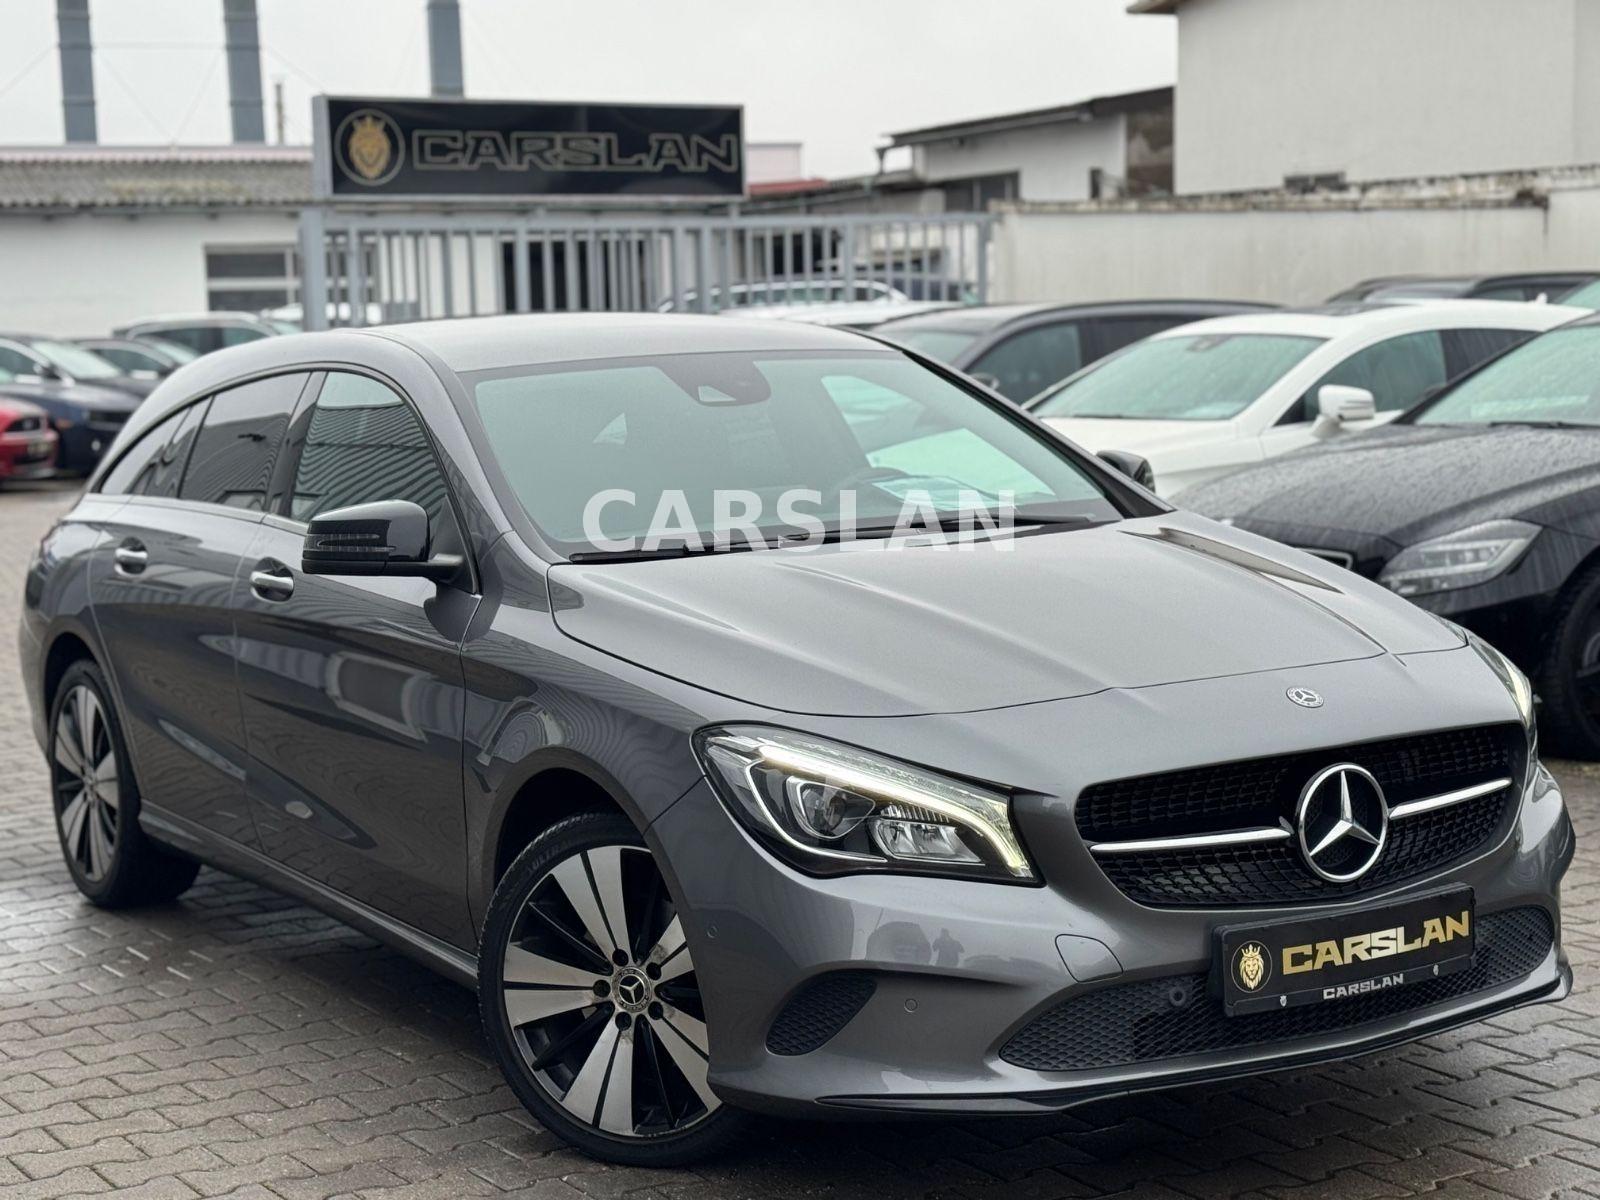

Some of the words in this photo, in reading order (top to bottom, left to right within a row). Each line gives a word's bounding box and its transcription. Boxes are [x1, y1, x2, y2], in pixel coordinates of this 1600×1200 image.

[413, 130, 738, 172] CARSLAN
[1283, 911, 1469, 975] CARSLAN
[1323, 973, 1404, 1000] CARSLAN
